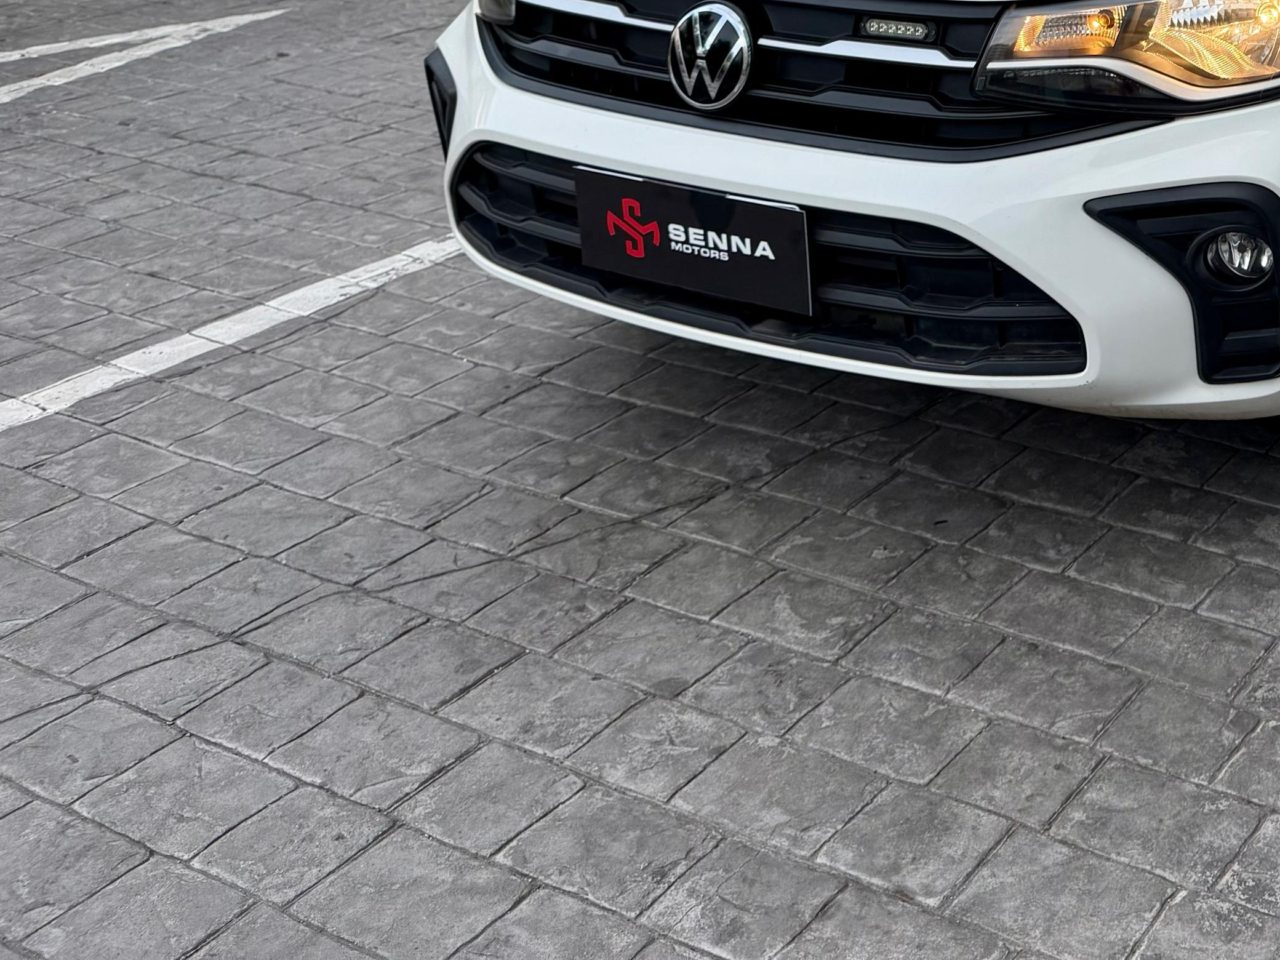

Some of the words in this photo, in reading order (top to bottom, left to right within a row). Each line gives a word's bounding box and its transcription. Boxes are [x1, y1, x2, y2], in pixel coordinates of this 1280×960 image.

[670, 4, 749, 105] VW
[668, 223, 775, 260] SENNA
[671, 241, 729, 261] MOTORS
